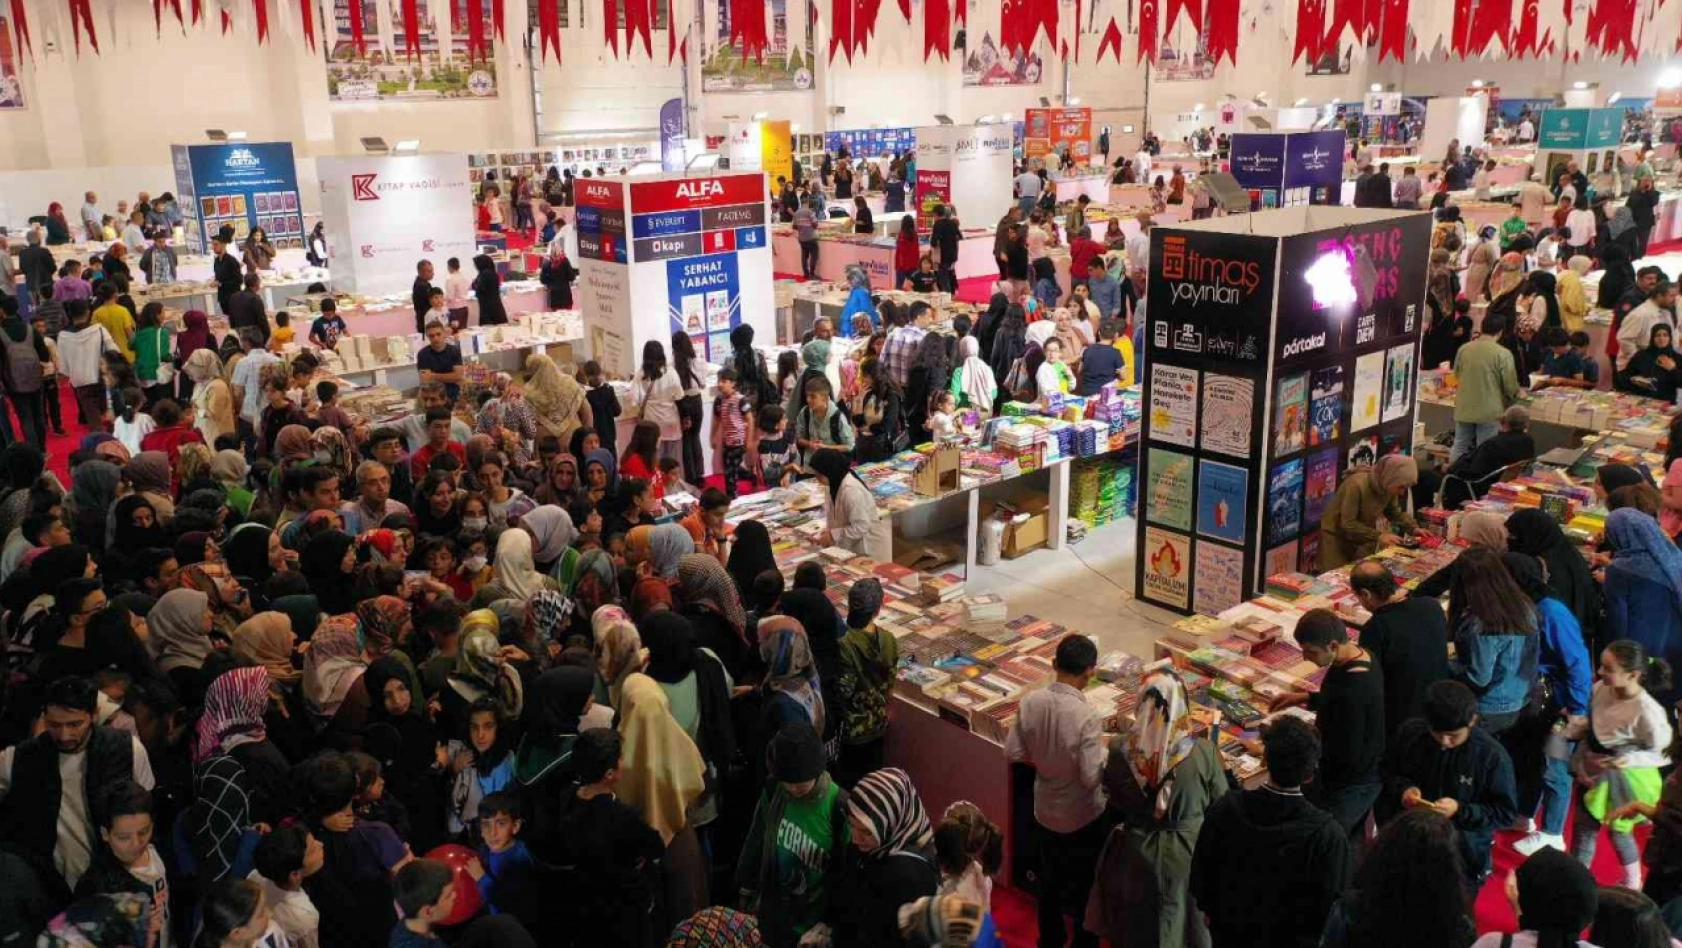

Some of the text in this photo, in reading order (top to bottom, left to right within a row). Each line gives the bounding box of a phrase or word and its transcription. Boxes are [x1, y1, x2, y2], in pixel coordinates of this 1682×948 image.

[587, 185, 611, 198] ALFA
[675, 180, 724, 199] ALFA
[684, 261, 722, 275] SERHAT
[1188, 249, 1260, 295] timaş
[679, 274, 729, 290] YABANCI
[1170, 276, 1239, 307] yayınları
